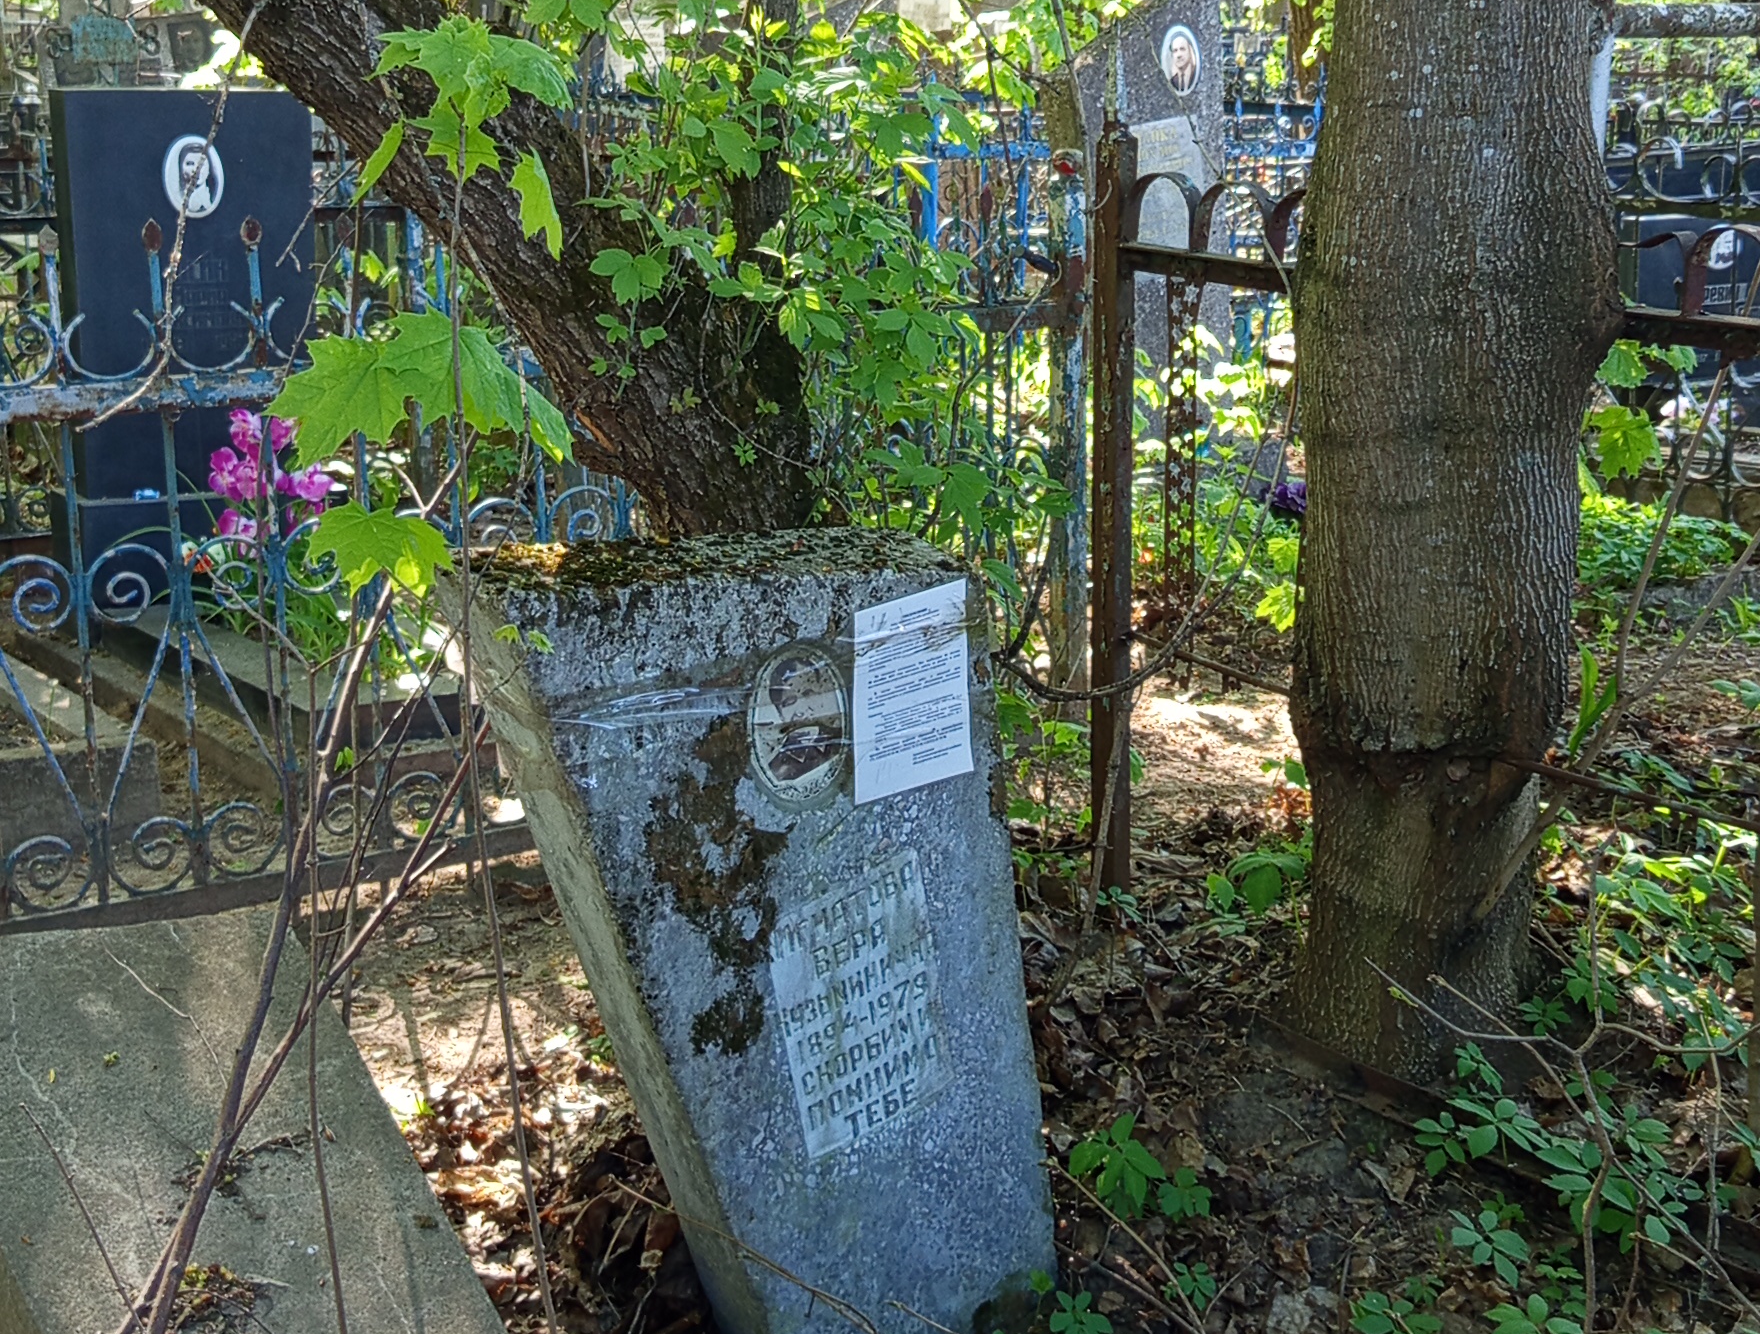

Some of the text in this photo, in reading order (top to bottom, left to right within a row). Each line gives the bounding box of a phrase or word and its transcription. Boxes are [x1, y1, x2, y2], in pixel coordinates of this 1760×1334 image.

[811, 918, 886, 979] ВЕРА
[797, 971, 927, 1065] 1894-1979
[801, 1013, 911, 1095] СКОРБИМ
[807, 1044, 918, 1131] ПОМНИМ
[844, 1078, 918, 1139] ТЕБЕ
